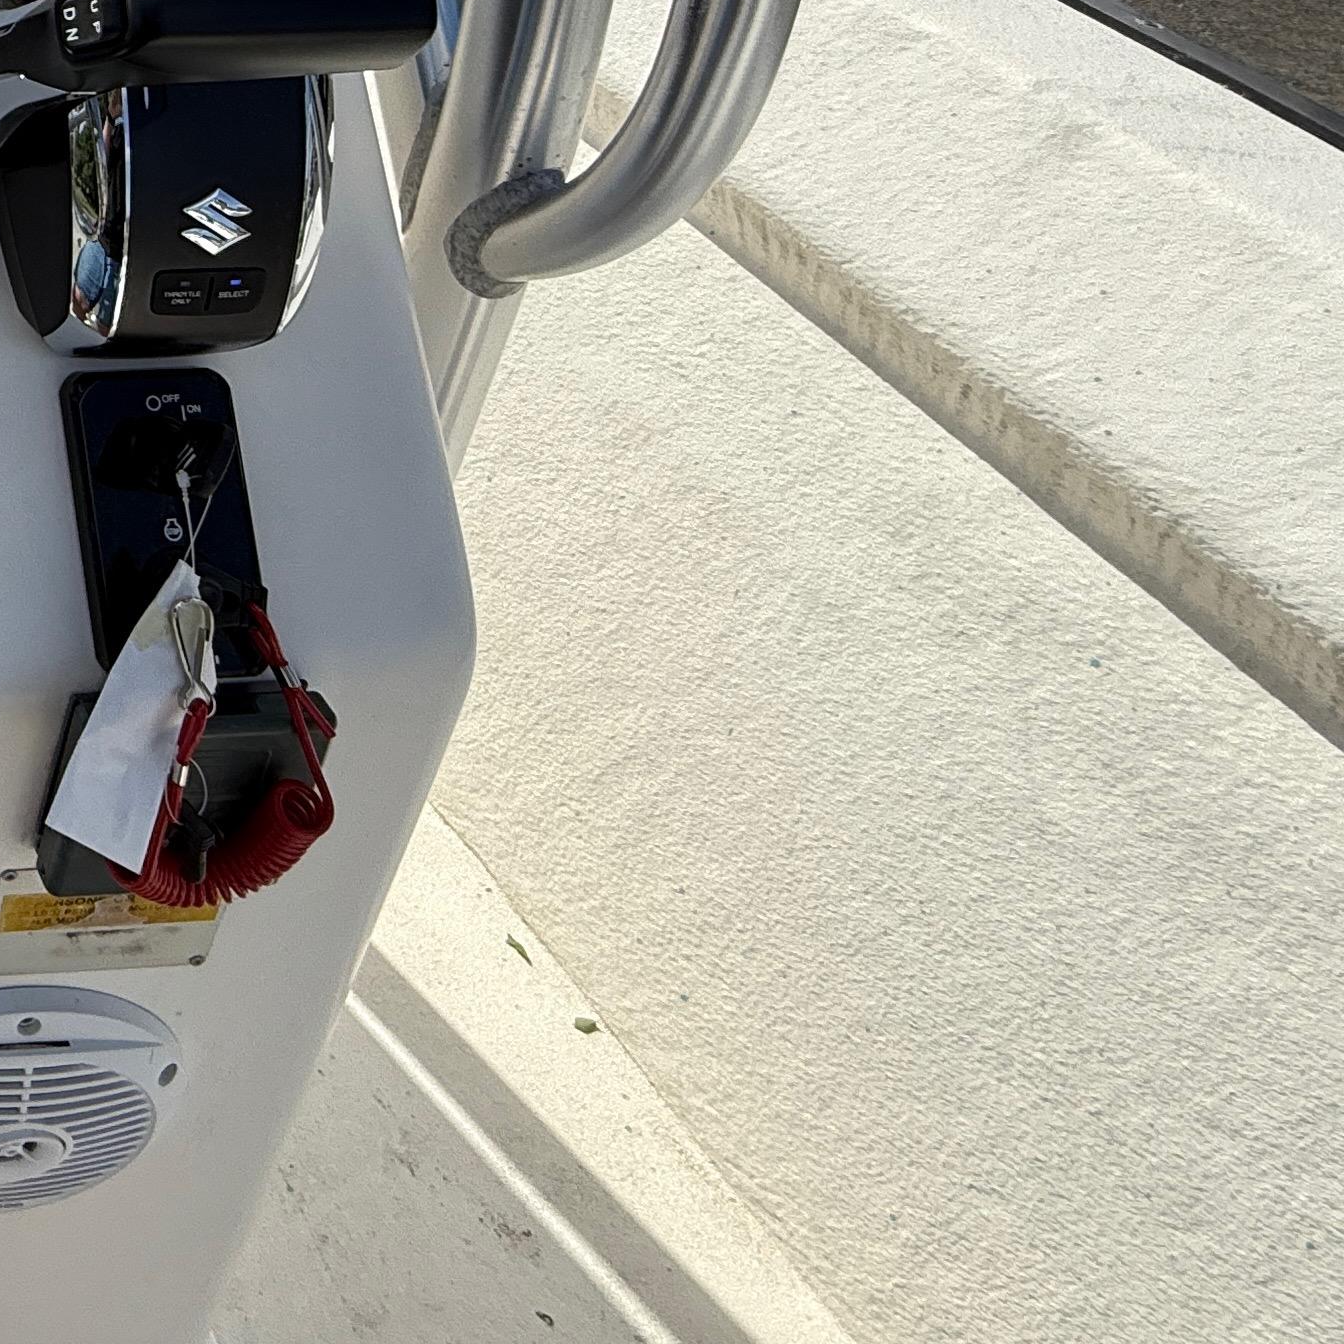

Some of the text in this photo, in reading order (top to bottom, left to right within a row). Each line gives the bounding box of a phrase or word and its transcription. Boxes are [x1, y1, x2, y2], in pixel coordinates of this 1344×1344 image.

[217, 289, 250, 299] SELECT
[162, 393, 180, 403] OFF
[186, 404, 202, 414] ON
